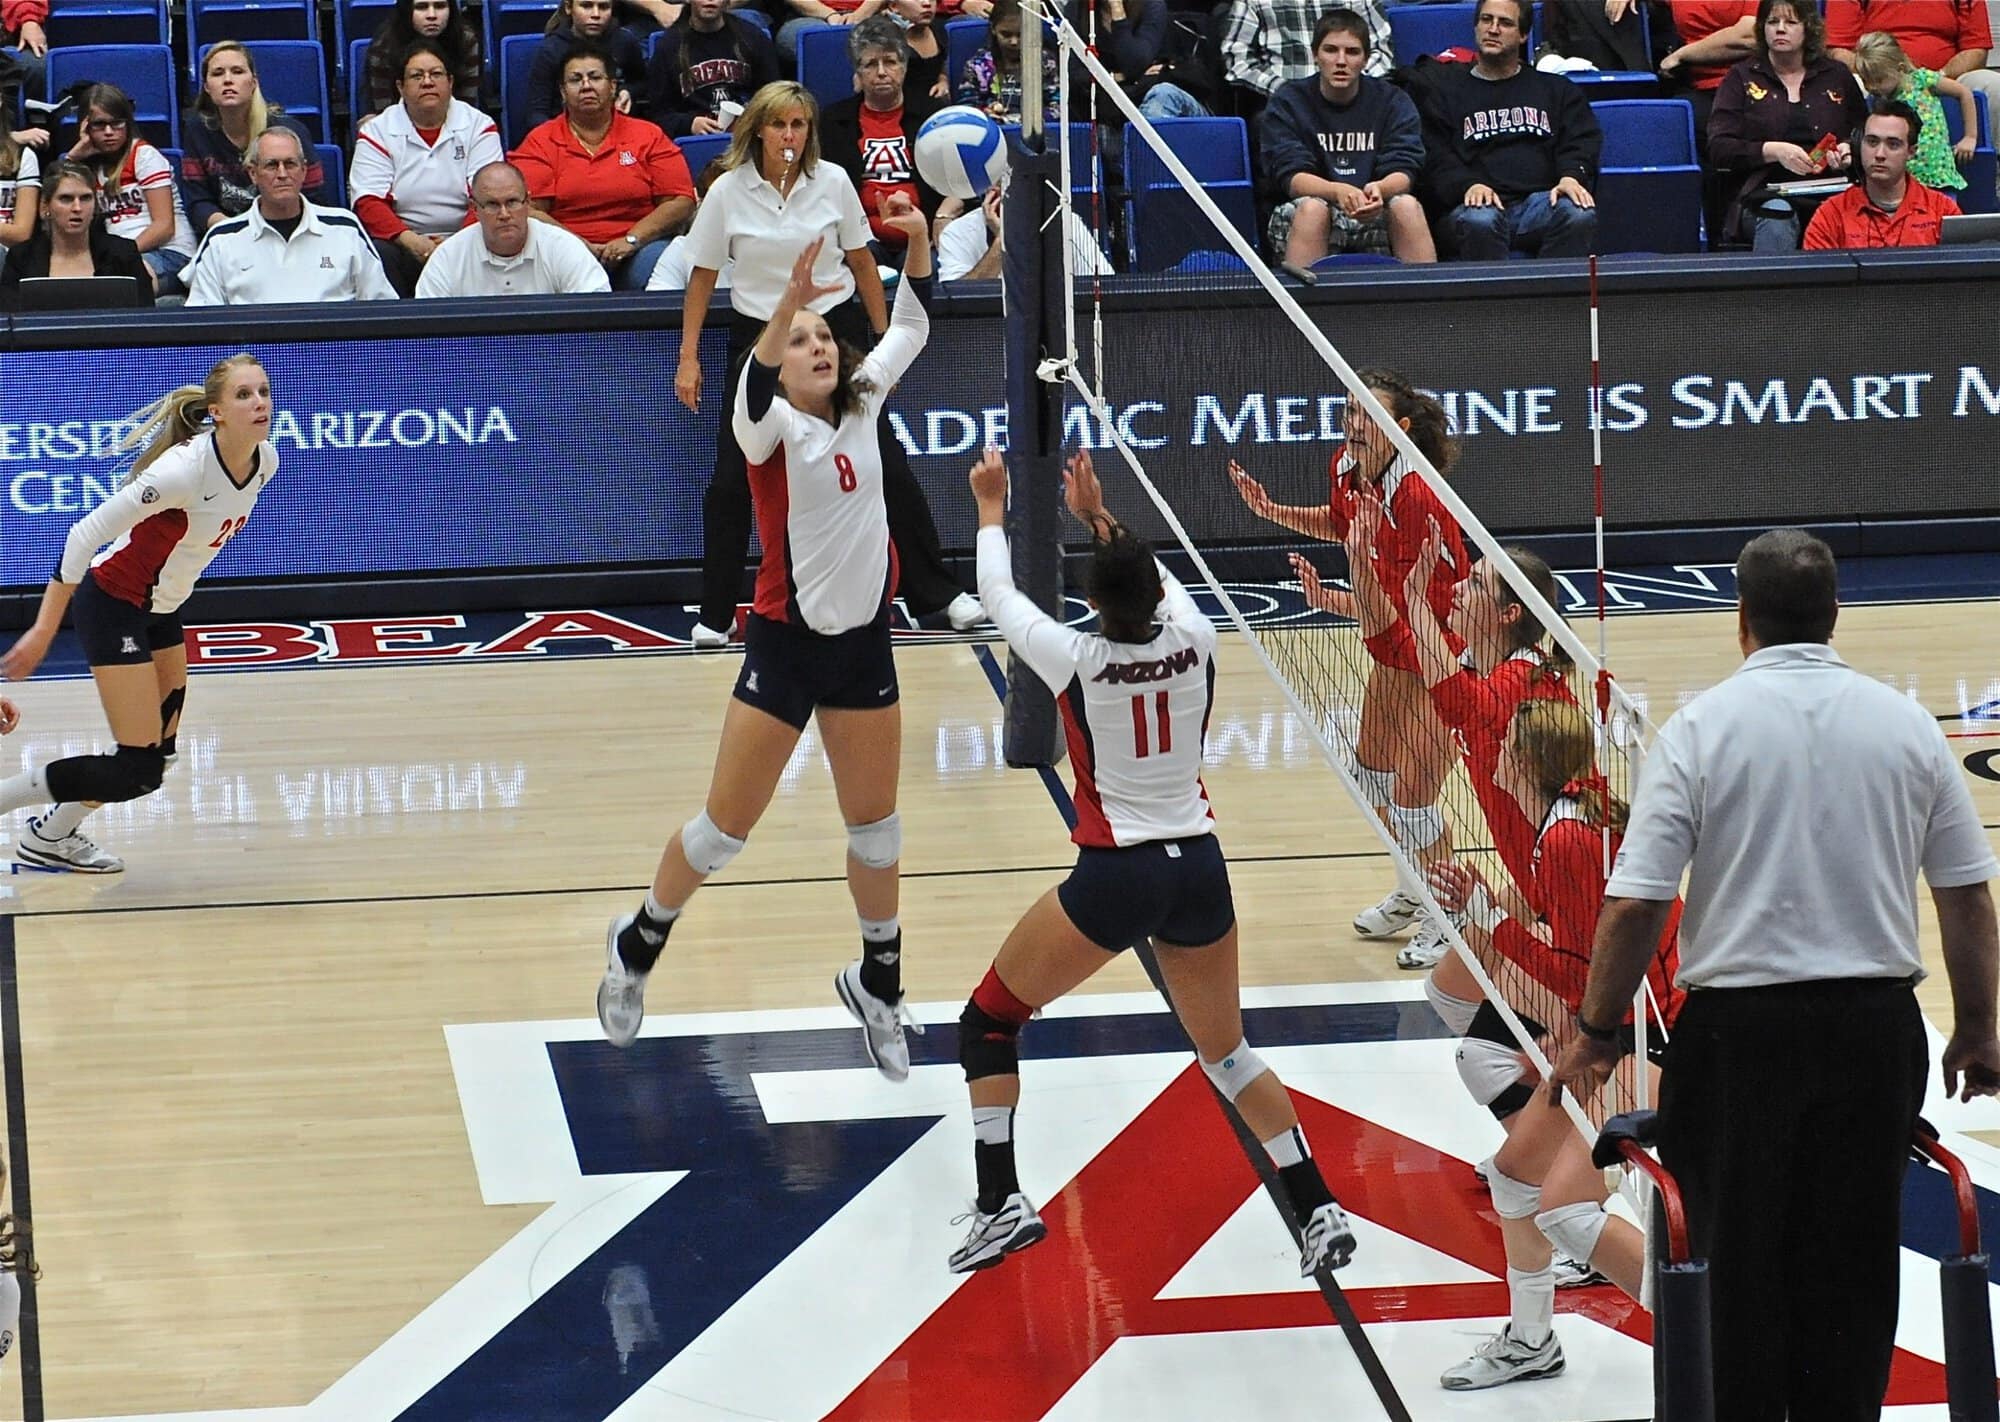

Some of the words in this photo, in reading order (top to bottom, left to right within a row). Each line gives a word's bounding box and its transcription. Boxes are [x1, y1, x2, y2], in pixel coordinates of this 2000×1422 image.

[1463, 106, 1552, 140] ARIZONA
[1587, 383, 1650, 431] IS
[1671, 374, 1934, 429] SMART
[269, 406, 519, 450] ARIZONA
[834, 453, 857, 493] 8
[1091, 646, 1199, 685] ARIZONA
[1131, 690, 1171, 759] 11
